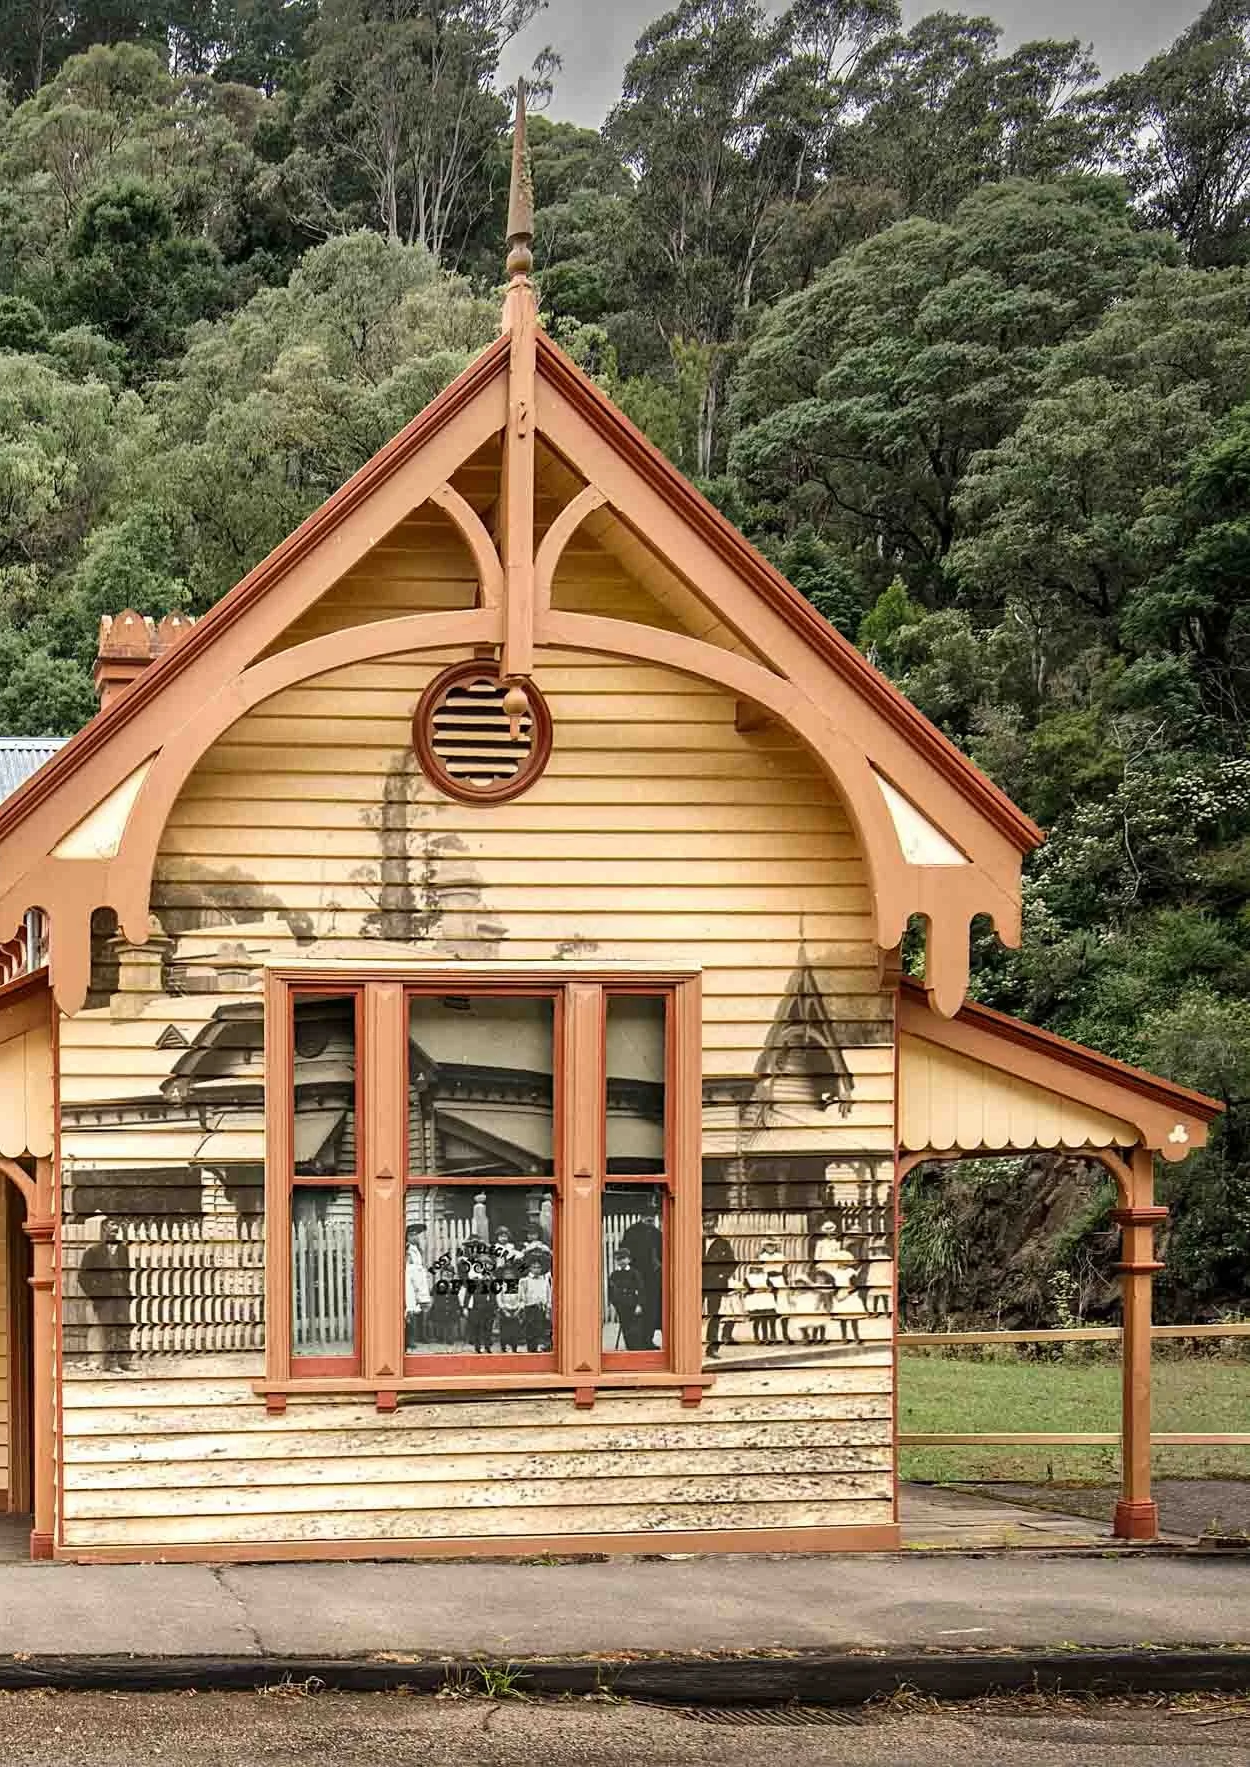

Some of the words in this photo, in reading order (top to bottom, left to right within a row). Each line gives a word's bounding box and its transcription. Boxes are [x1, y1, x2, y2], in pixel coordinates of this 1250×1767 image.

[428, 1252, 452, 1275] POST
[467, 1243, 530, 1273] TELEGRAH
[436, 1279, 518, 1294] OFFICE
